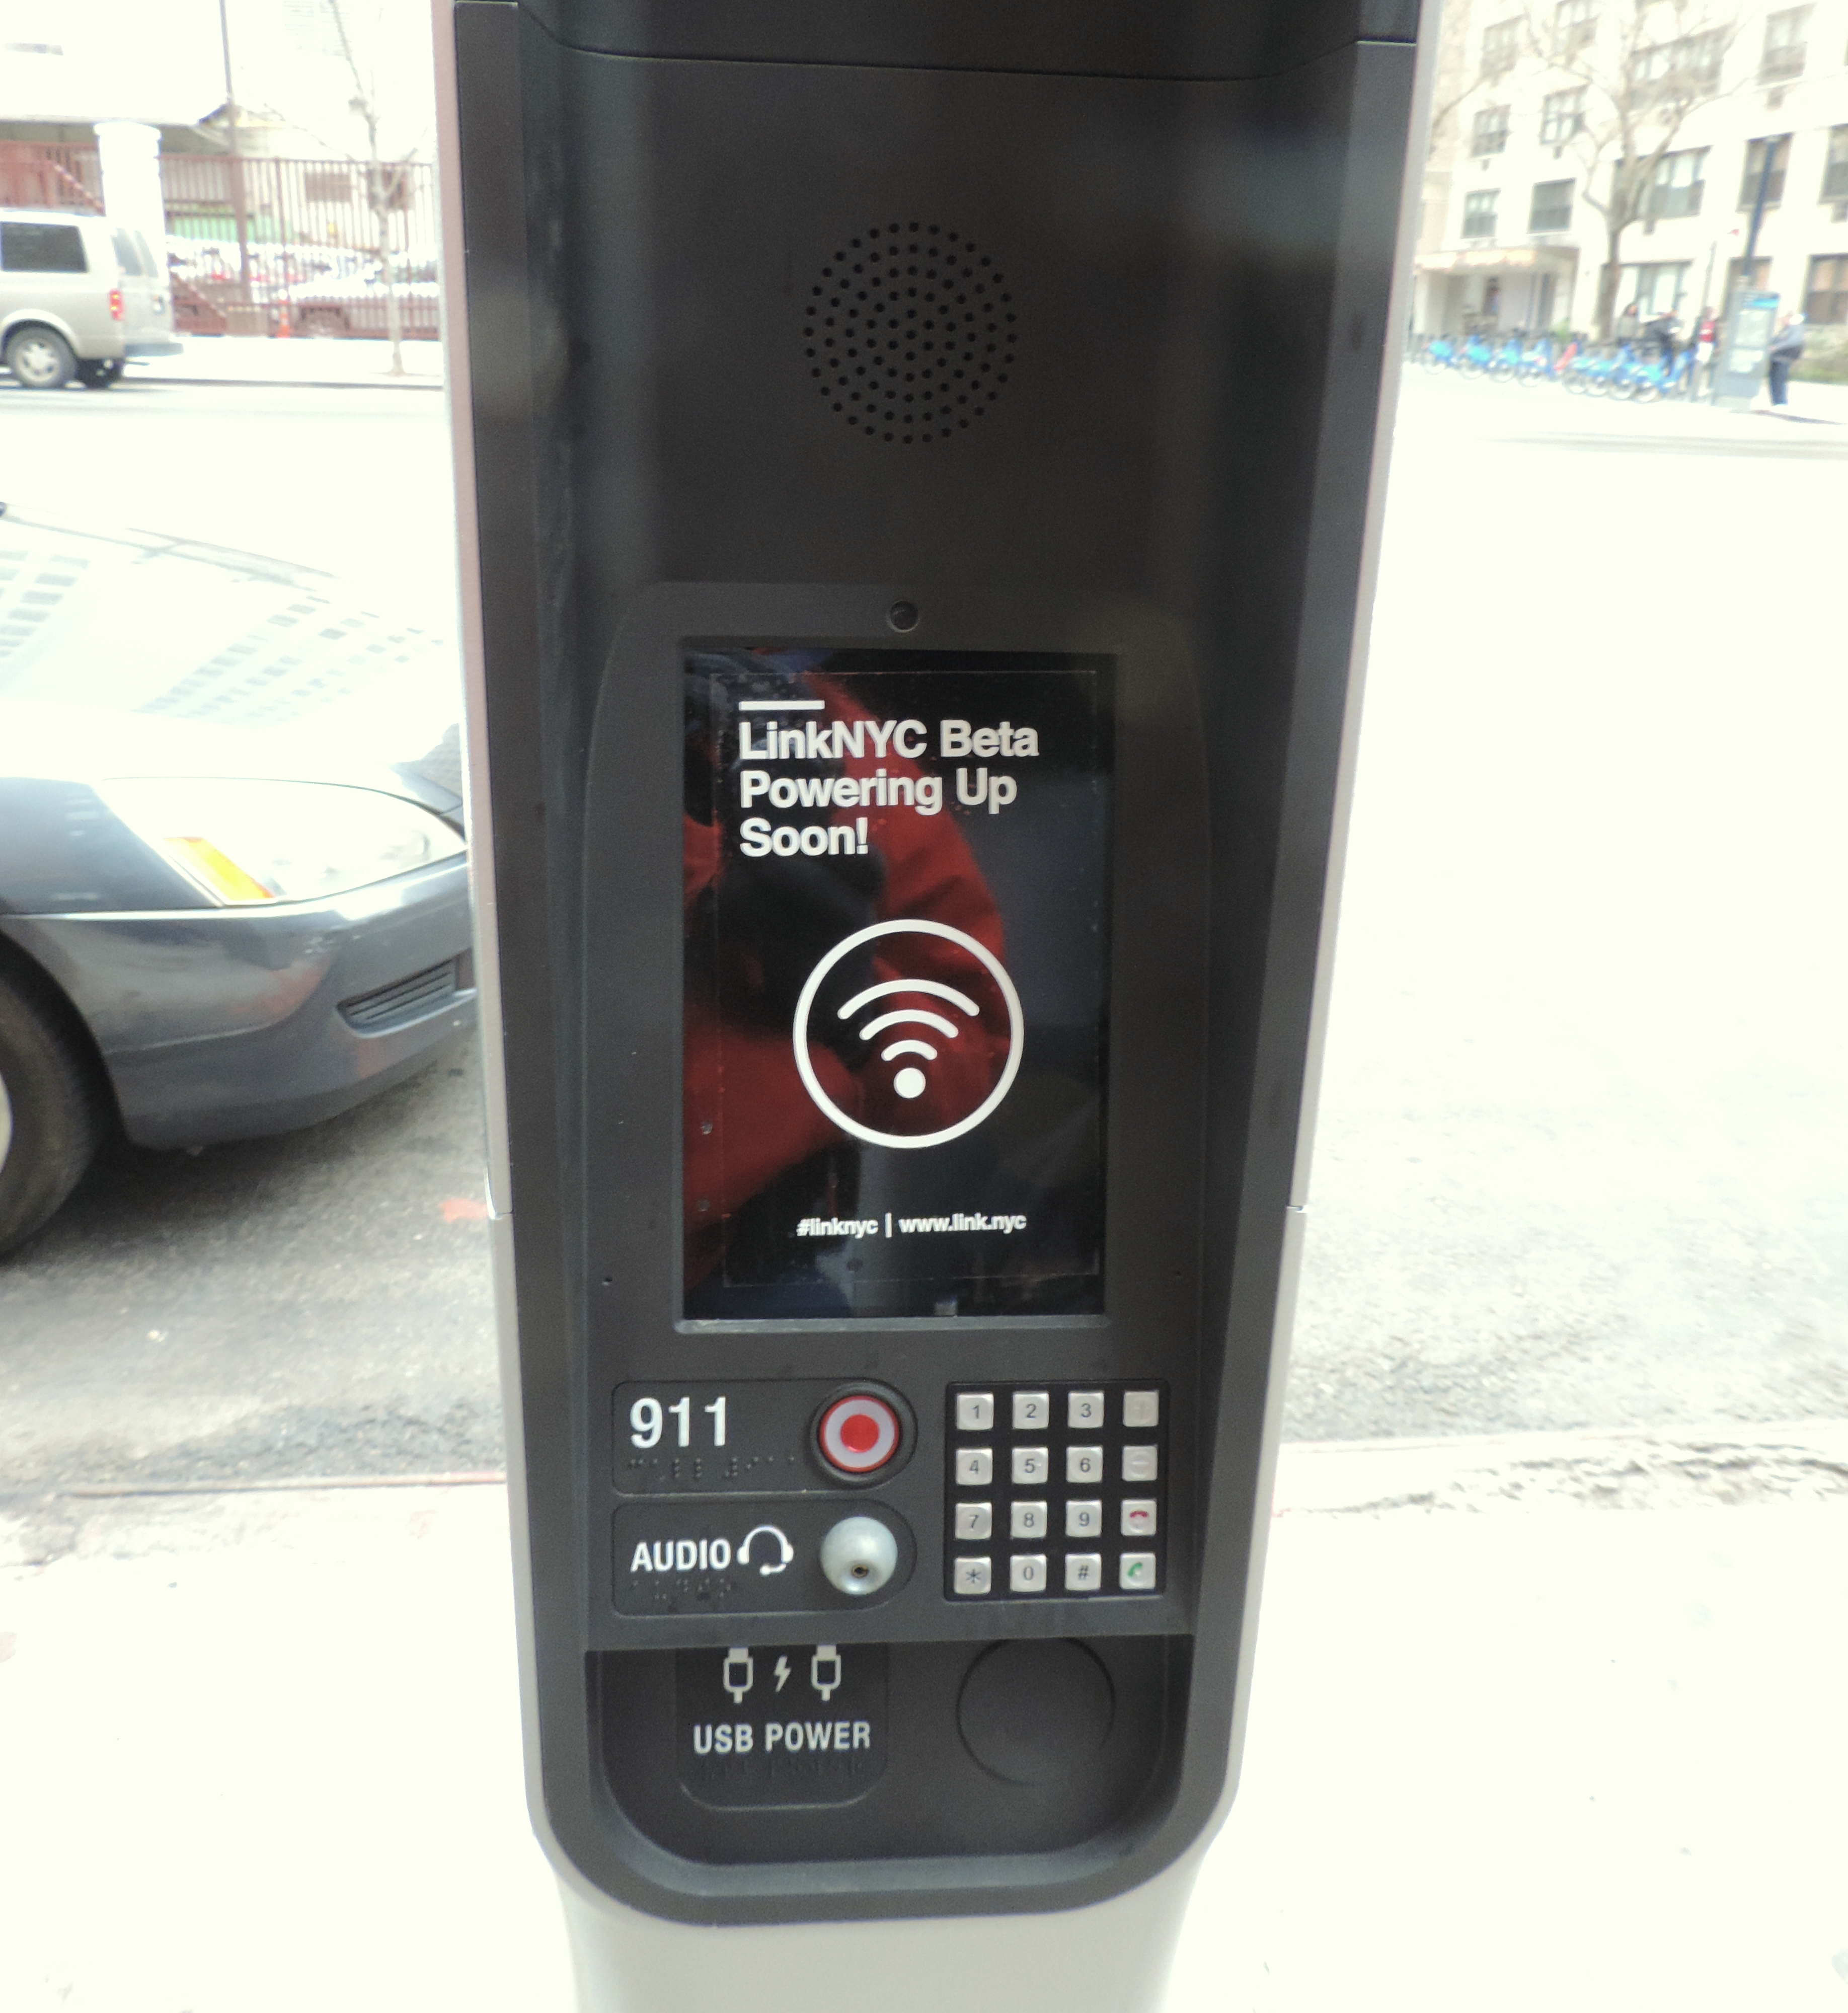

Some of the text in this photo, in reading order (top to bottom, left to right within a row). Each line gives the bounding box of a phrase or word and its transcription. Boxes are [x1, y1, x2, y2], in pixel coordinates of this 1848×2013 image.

[738, 719, 1040, 761] LinkNYC Beta
[740, 767, 1018, 816] Powering Up
[739, 816, 869, 858] Soon!
[796, 1217, 879, 1239] #linknyc
[897, 1212, 1027, 1234] www.link.nyc
[630, 1396, 726, 1449] 911
[972, 1402, 1093, 1420] 1 2 3
[968, 1457, 1092, 1474] 4 5 6
[969, 1511, 1091, 1529] 7 8 9
[630, 1538, 732, 1573] AUDIO
[1022, 1565, 1035, 1581] 0
[1077, 1564, 1090, 1580] #
[693, 1721, 871, 1755] USB POWER
